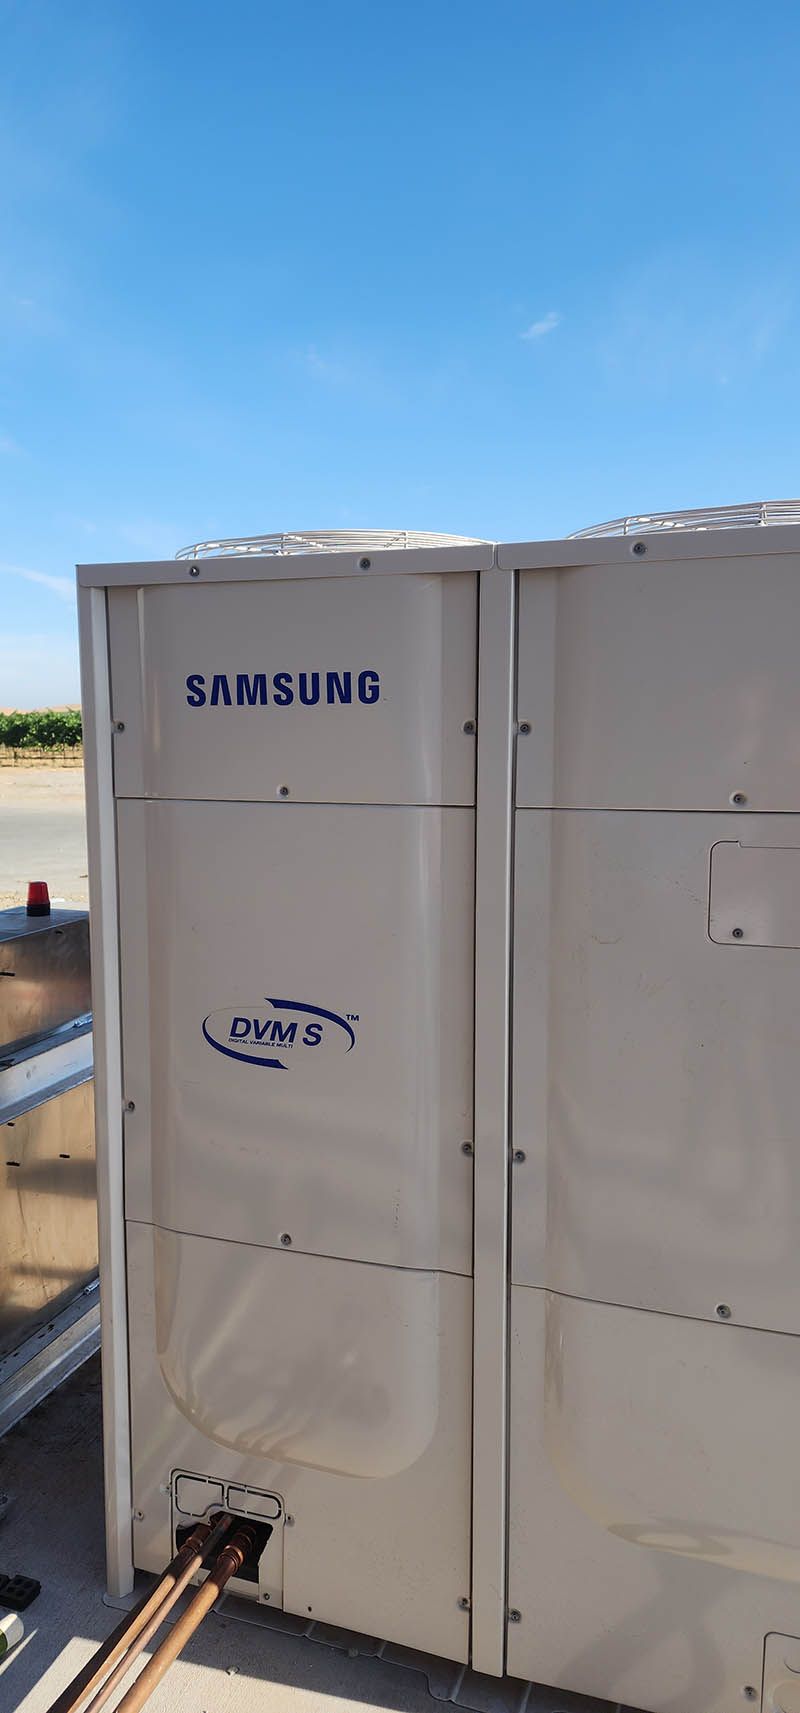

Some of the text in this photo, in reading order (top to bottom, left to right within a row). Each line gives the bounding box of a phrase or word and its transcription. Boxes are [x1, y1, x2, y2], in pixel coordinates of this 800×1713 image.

[186, 670, 380, 707] SAMSUNG
[229, 1017, 323, 1046] DVM S
